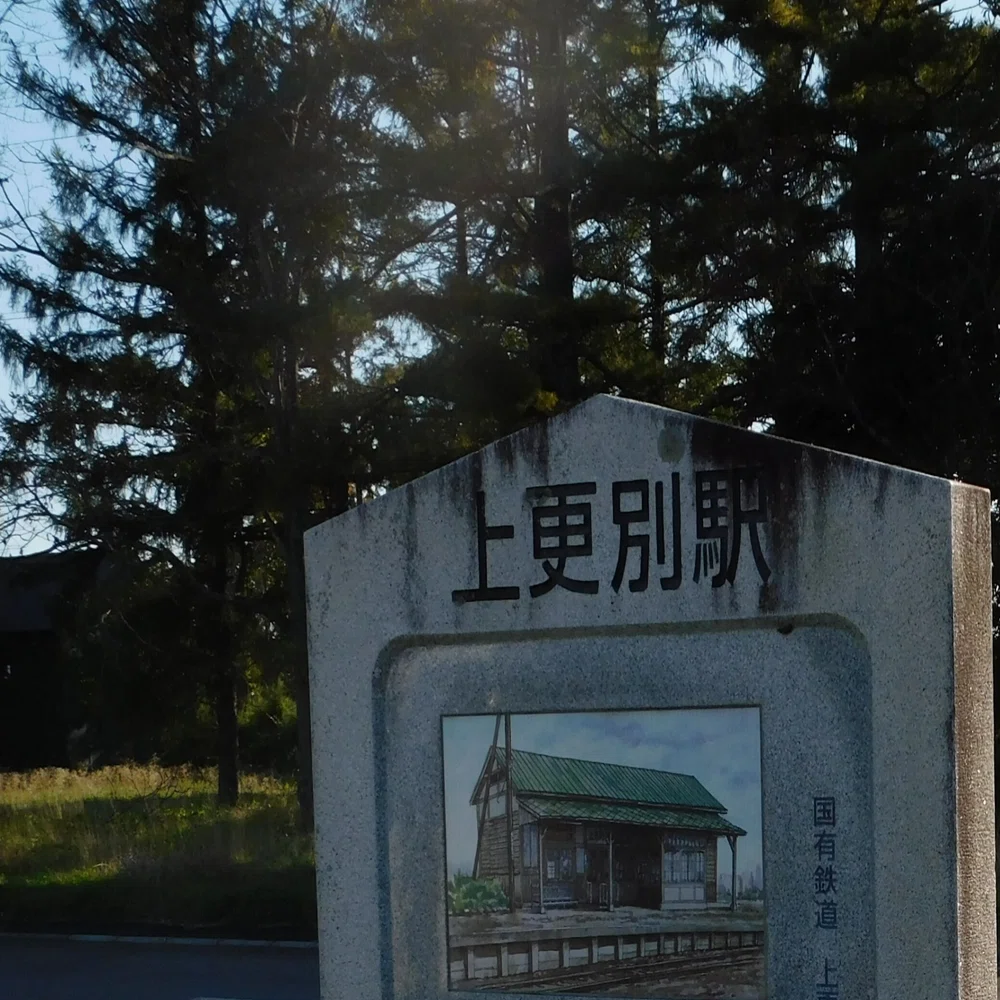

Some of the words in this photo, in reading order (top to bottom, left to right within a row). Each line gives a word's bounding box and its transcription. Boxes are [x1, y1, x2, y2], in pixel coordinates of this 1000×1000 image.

[452, 470, 771, 602] 上更別駅
[813, 796, 838, 930] 国有鉄道
